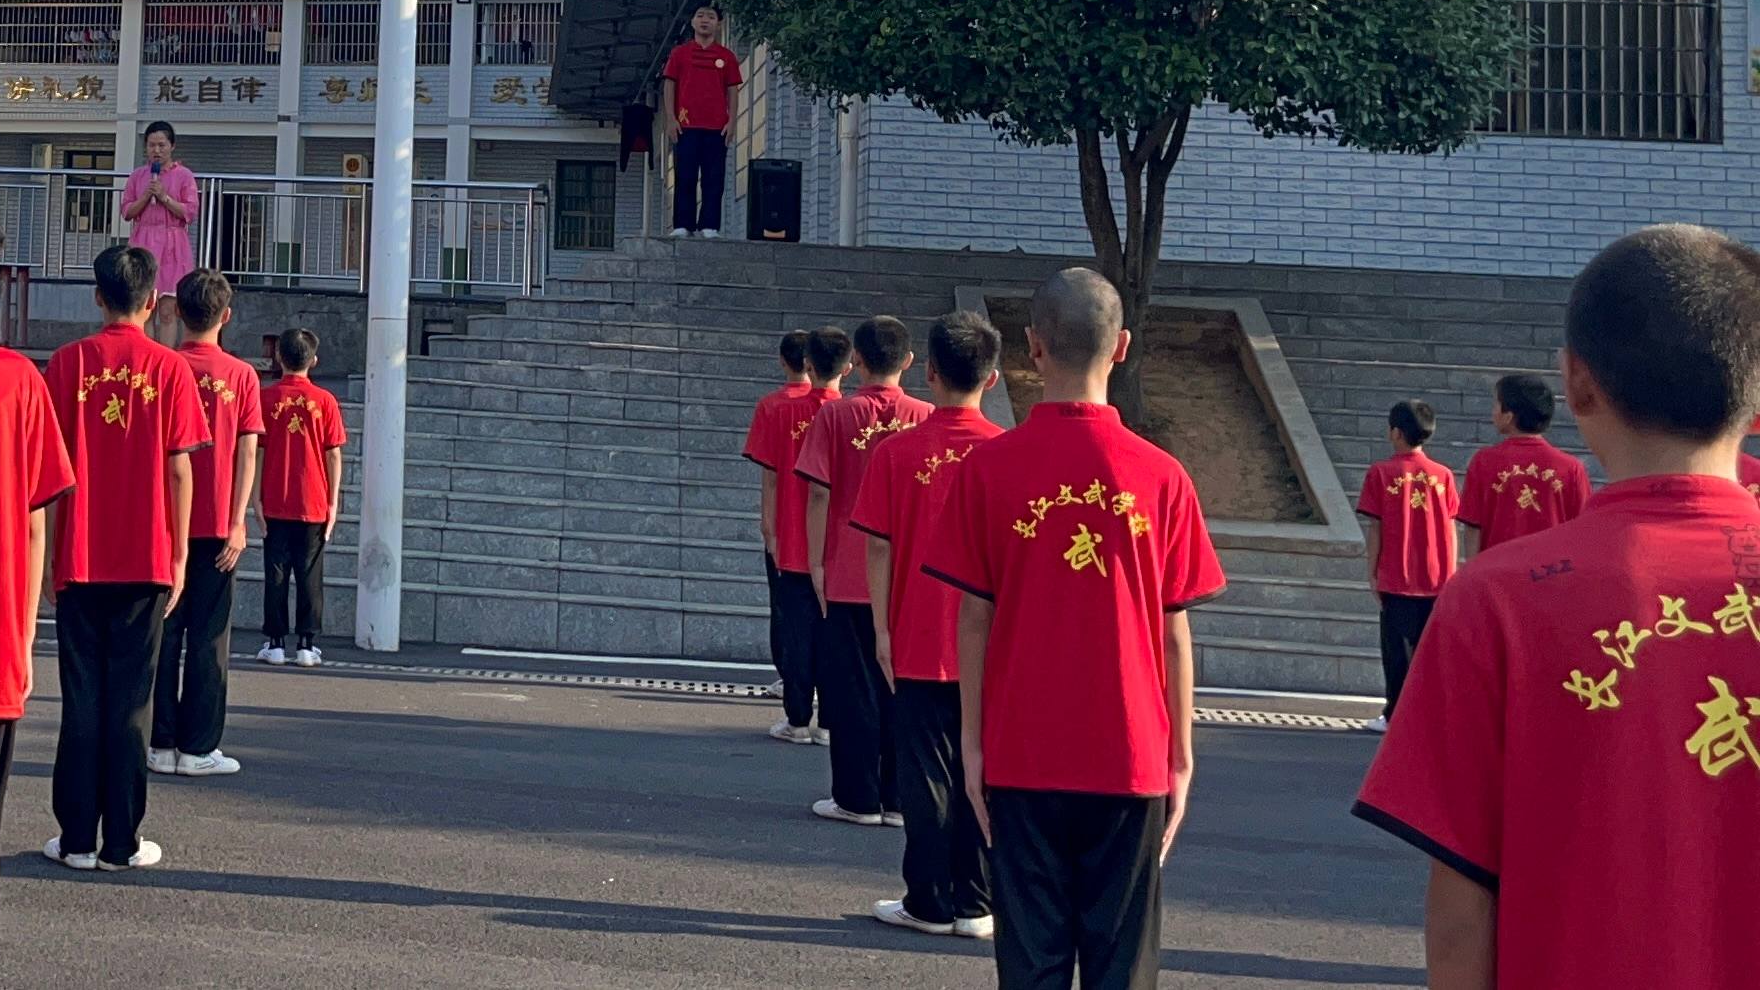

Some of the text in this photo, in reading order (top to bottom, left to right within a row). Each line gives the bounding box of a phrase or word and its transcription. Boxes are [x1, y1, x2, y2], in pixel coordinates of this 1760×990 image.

[154, 75, 267, 103] 能自律
[101, 392, 127, 429] 武
[1516, 483, 1542, 513] 武
[1063, 523, 1108, 578] 武
[1684, 675, 1760, 778] 武
